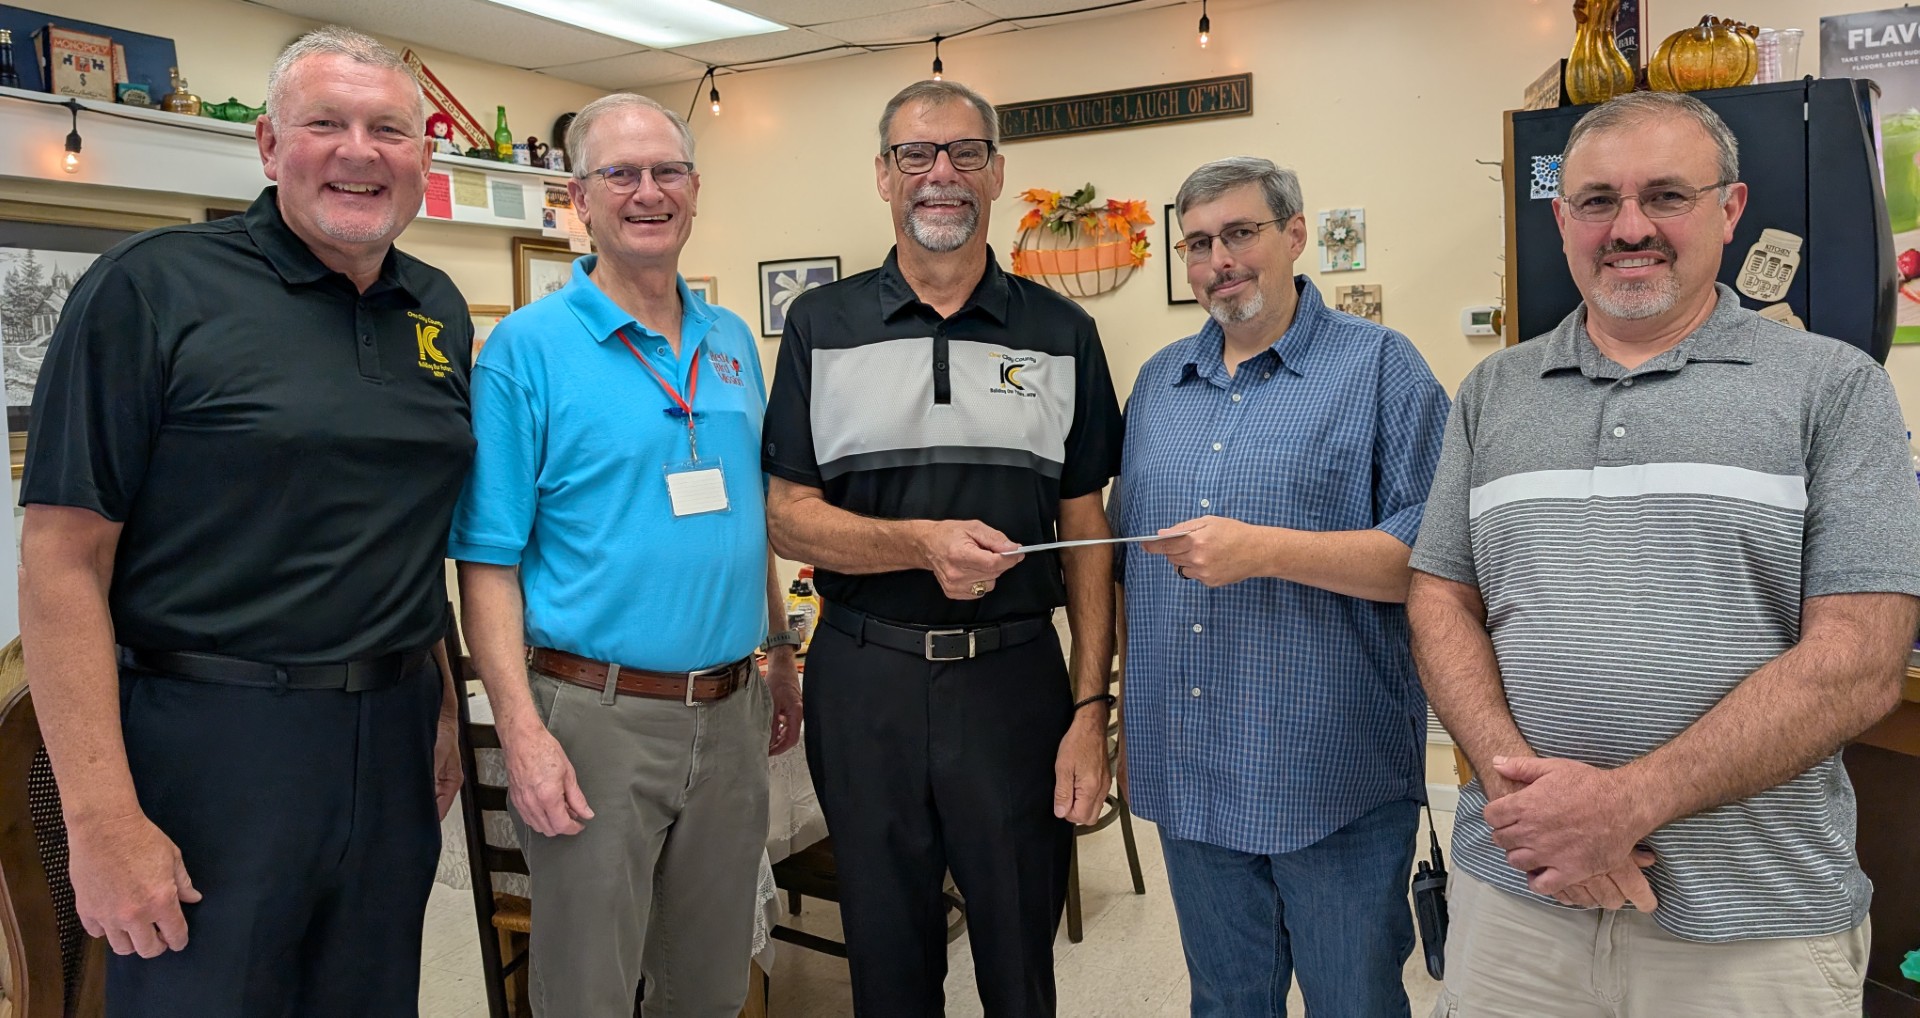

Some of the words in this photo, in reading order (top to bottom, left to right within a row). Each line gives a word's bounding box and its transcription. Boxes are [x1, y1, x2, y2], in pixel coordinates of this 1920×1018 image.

[1848, 22, 1920, 50] FLAV
[54, 39, 109, 55] MONOPOLY
[1881, 51, 1902, 59] TASTE
[1887, 59, 1919, 67] EXPLORE
[417, 69, 489, 148] EXTINGUISHER
[1020, 104, 1061, 134] TALK
[1067, 99, 1112, 128] MUCH
[1123, 90, 1179, 121] LAUGH
[1188, 82, 1242, 113] OFTEN
[1764, 244, 1791, 257] KITCHEN
